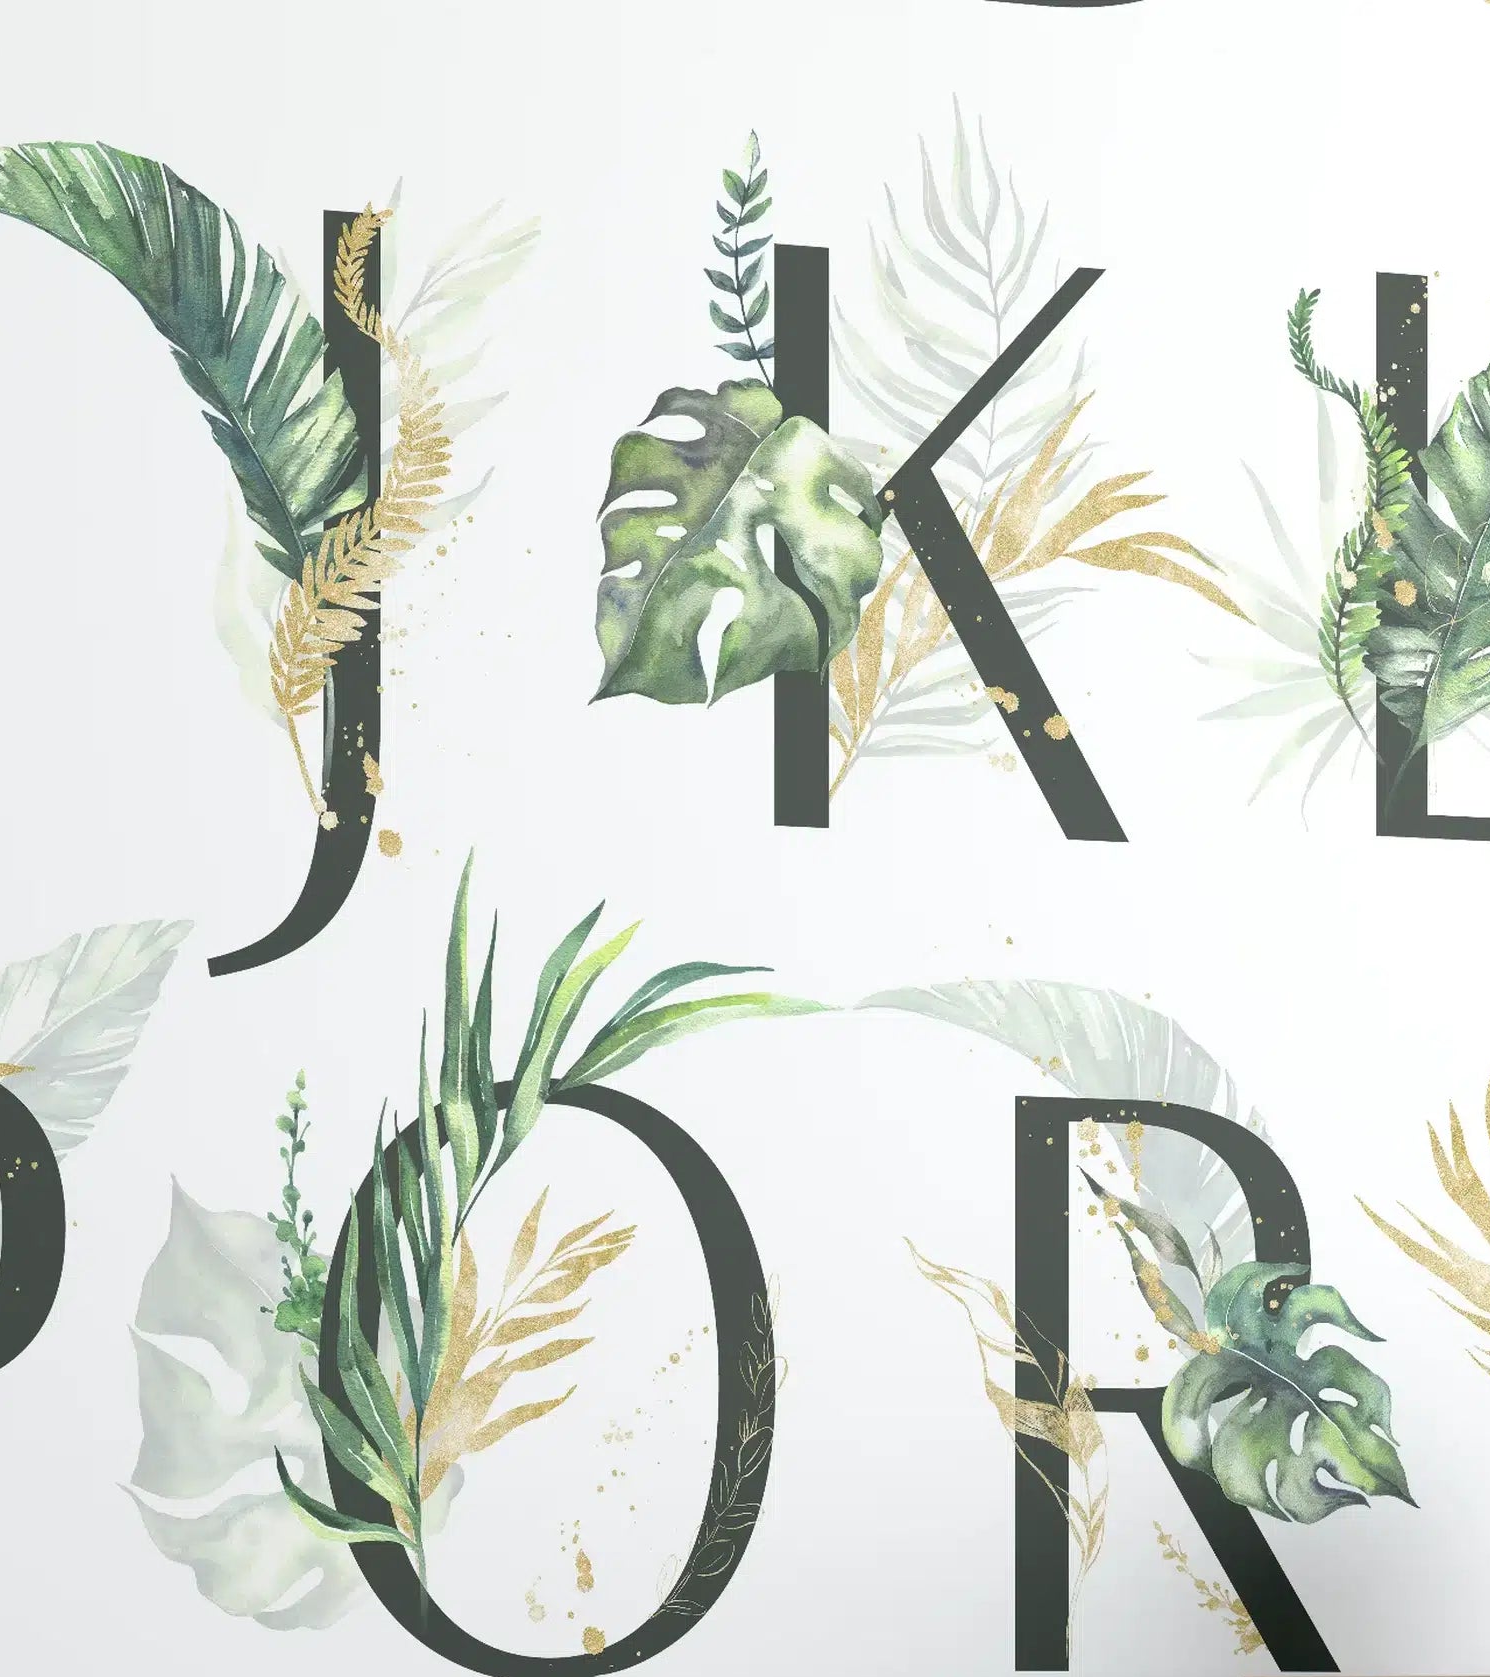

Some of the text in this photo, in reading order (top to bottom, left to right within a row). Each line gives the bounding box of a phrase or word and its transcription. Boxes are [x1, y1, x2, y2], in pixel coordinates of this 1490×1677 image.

[207, 209, 381, 977] J
[774, 243, 1129, 842] K
[1014, 1095, 1342, 1672] R
